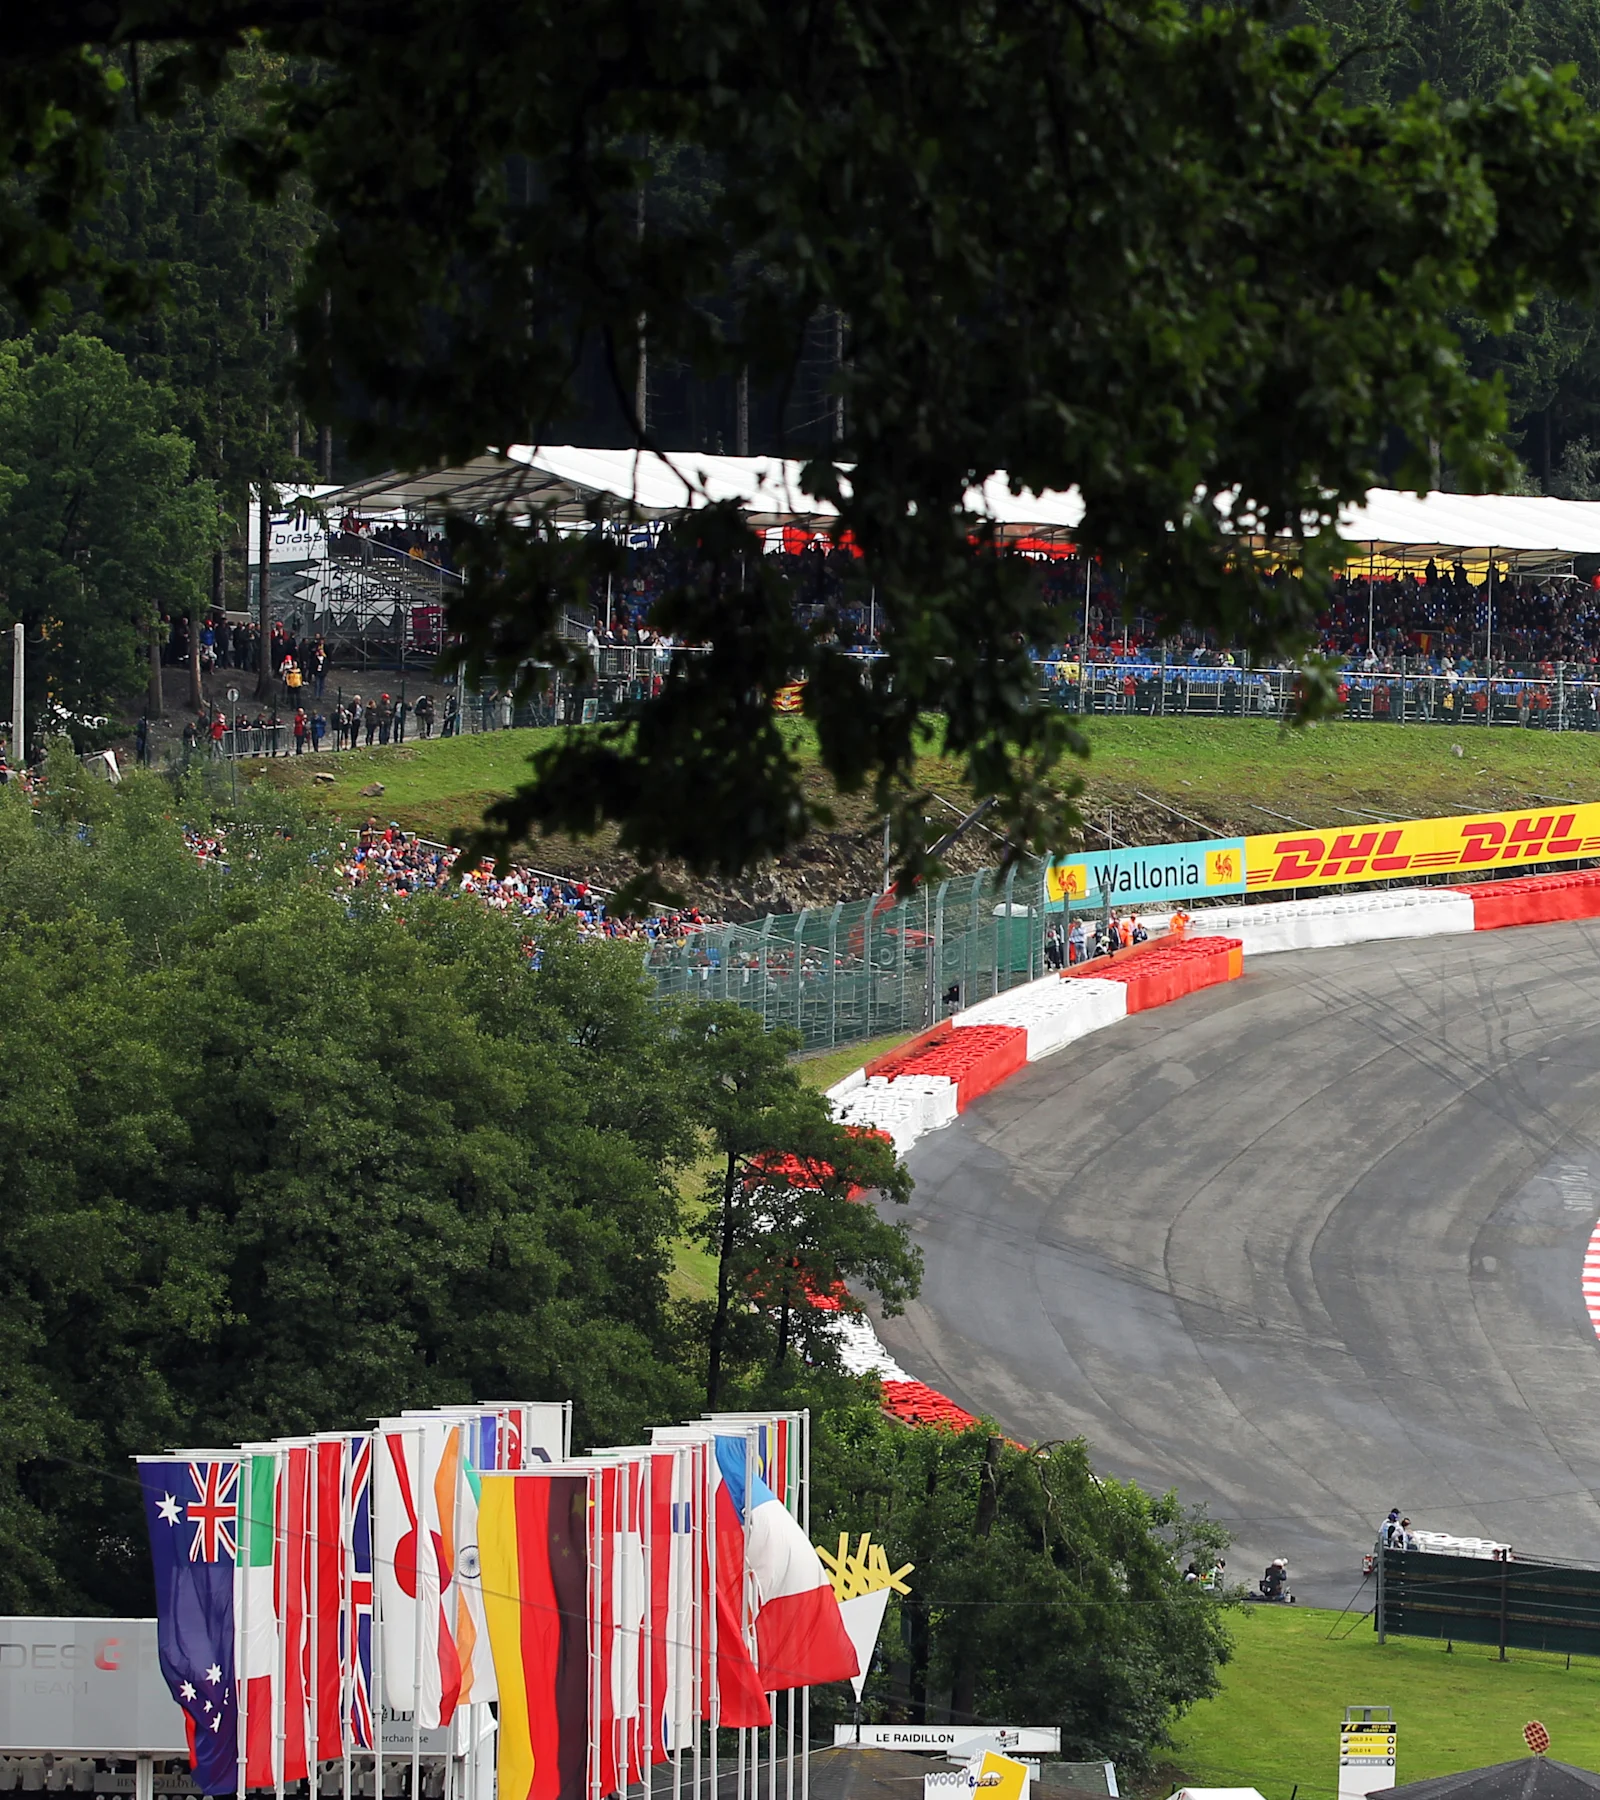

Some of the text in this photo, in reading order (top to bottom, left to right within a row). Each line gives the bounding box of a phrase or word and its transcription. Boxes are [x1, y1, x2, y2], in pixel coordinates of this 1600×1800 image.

[1272, 829, 1412, 882] DHL
[1459, 814, 1583, 864] DHL
[1094, 856, 1200, 893] Wallonia
[876, 1733, 955, 1743] LE RAIDILLON
